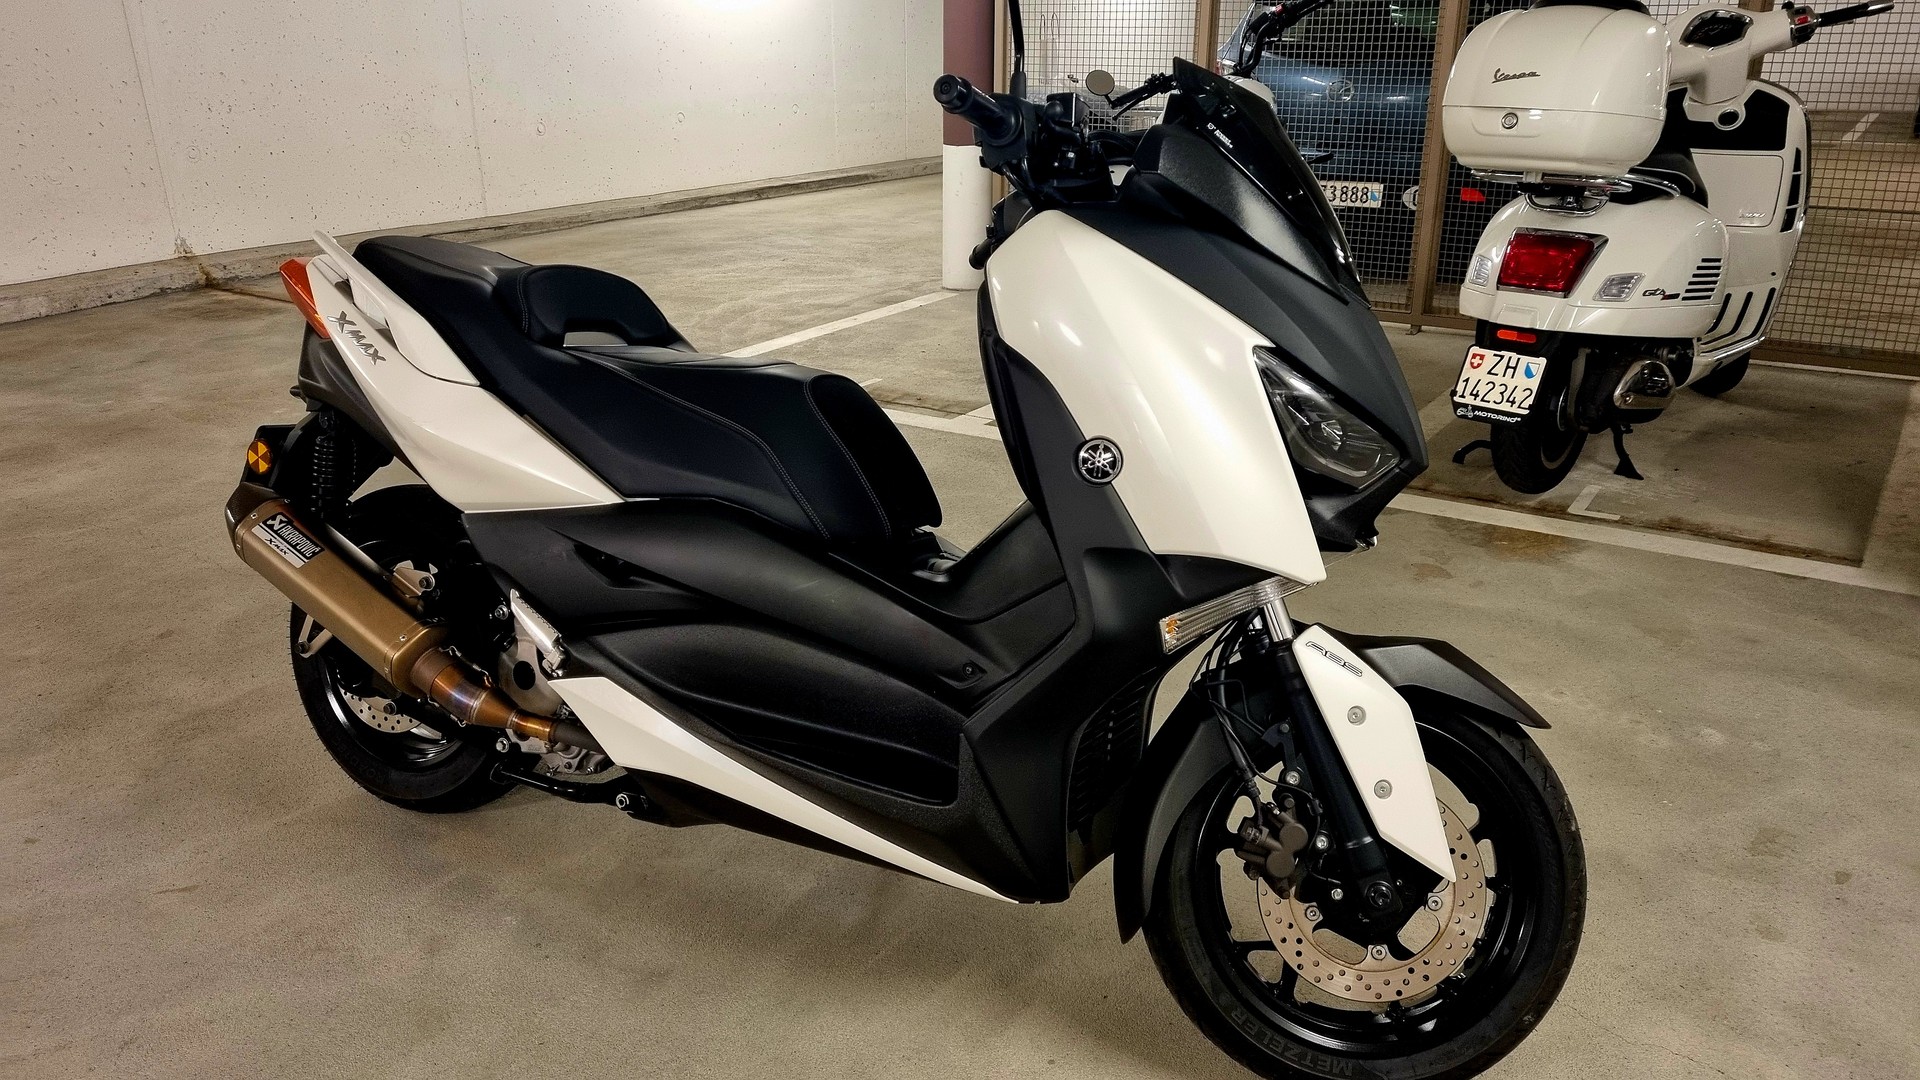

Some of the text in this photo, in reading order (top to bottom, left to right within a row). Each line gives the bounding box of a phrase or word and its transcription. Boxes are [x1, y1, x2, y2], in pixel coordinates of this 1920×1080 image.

[1486, 353, 1521, 379] ZH
[1458, 377, 1533, 411] 142342
[1305, 640, 1363, 678] ABS
[1231, 1007, 1352, 1077] METZELER
